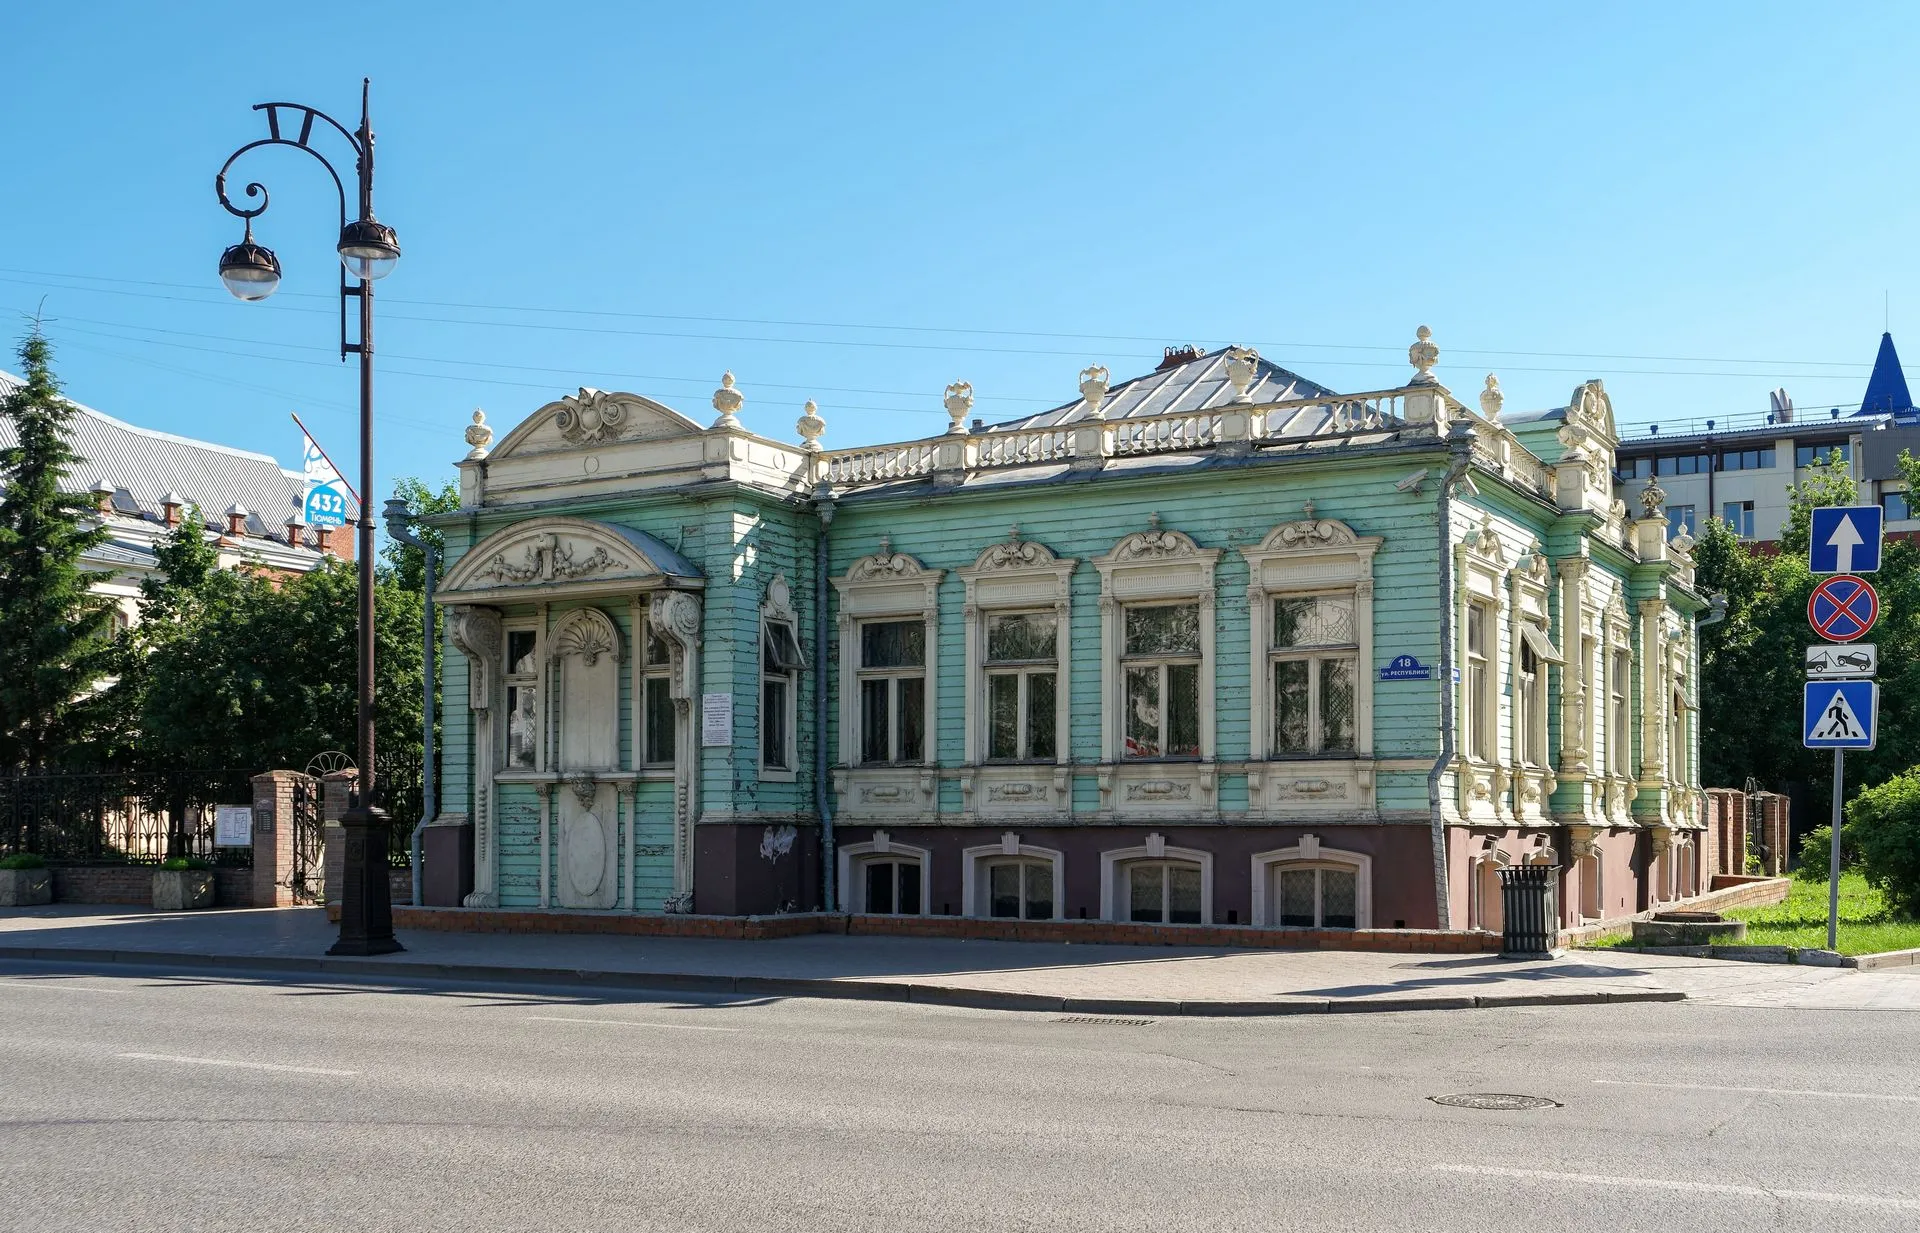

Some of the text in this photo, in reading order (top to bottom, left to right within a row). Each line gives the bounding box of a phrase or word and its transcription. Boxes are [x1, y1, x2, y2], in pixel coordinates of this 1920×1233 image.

[310, 493, 342, 513] 432
[310, 511, 342, 525] Тюмень
[1398, 658, 1412, 667] 18
